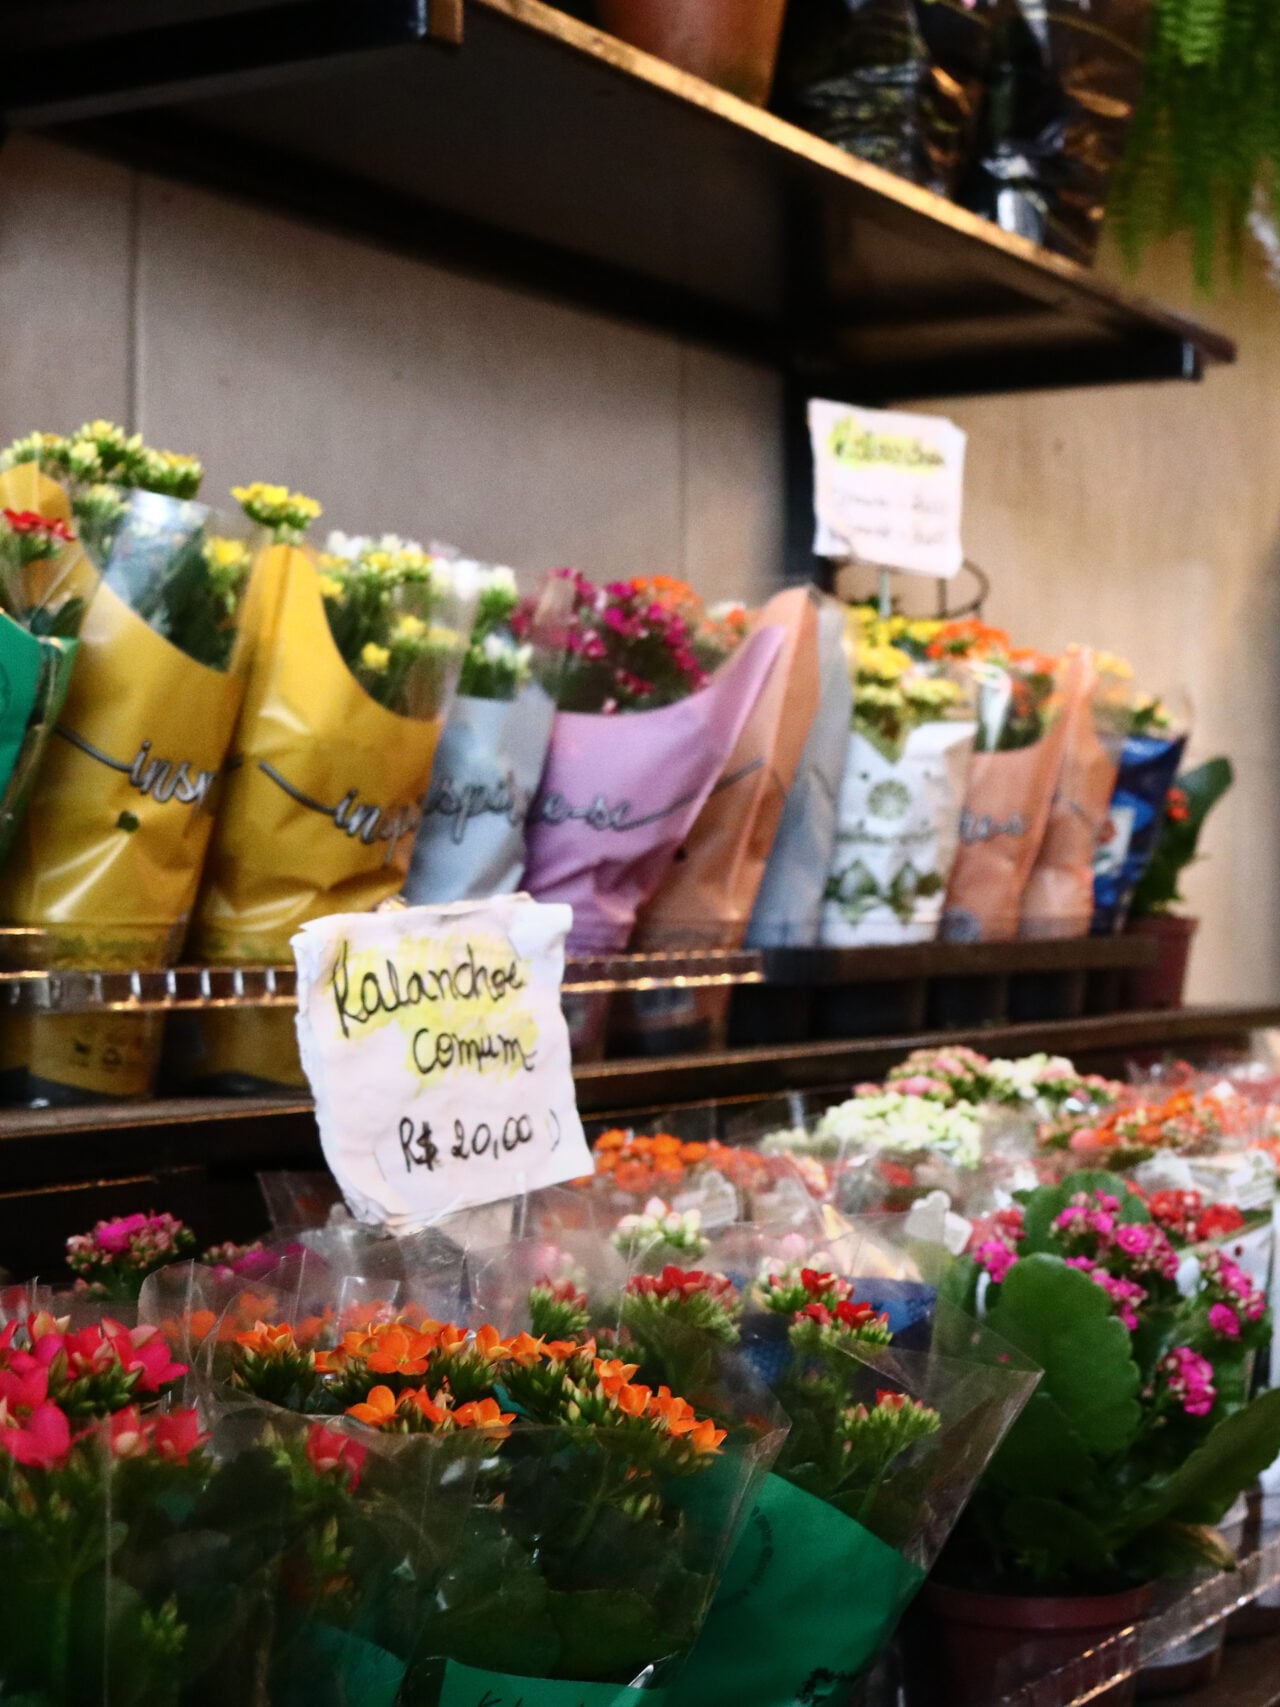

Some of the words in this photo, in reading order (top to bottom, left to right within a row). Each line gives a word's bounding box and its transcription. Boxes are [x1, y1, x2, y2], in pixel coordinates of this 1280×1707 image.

[331, 938, 525, 1038] Kalanchoe
[412, 1028, 537, 1076] Comum
[399, 1115, 440, 1173] R$
[450, 1113, 534, 1161] 20,00
